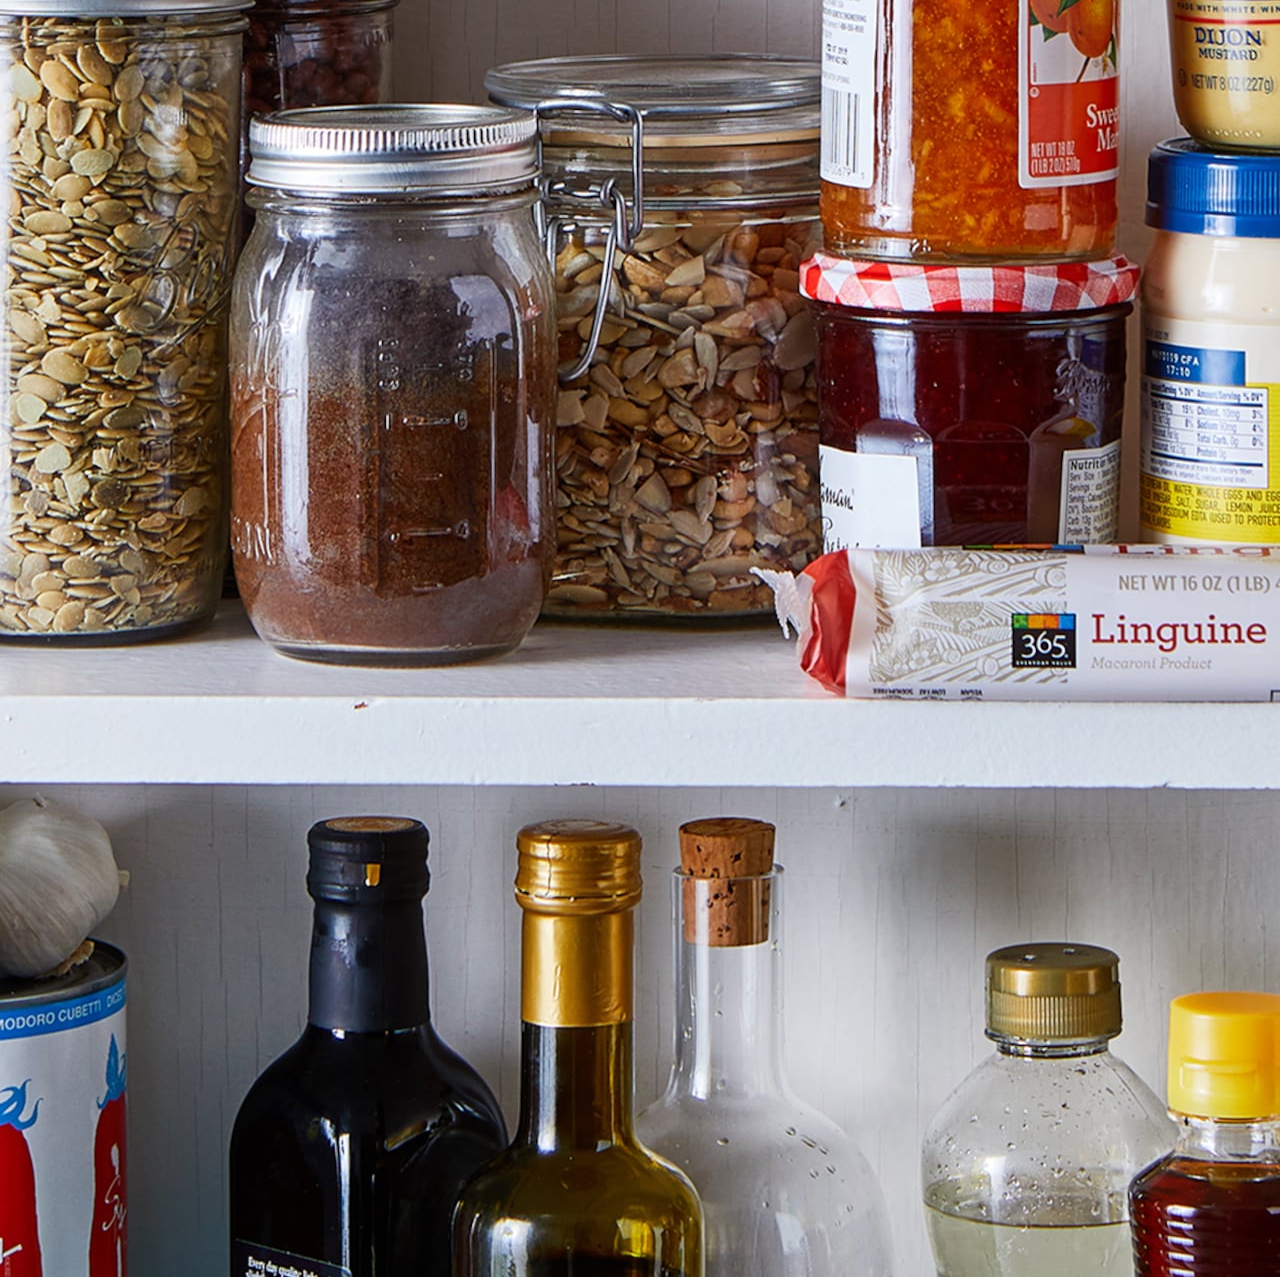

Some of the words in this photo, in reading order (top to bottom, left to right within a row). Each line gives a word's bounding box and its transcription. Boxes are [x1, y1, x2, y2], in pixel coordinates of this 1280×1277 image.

[1196, 3, 1219, 13] WITH
[1222, 4, 1256, 15] WHITE
[1194, 27, 1263, 48] DIJON
[1198, 48, 1259, 62] MUSTARD
[1227, 76, 1242, 92] OZ
[1242, 76, 1275, 94] (227g)
[1031, 142, 1045, 157] NET
[1046, 141, 1057, 157] WT
[1252, 423, 1264, 433] 4%
[1251, 436, 1264, 447] 0%
[1196, 486, 1220, 499] WHOLE
[1223, 489, 1243, 500] EGGS
[1245, 491, 1263, 501] AND
[1225, 502, 1253, 513] LEMON
[1234, 514, 1245, 525] TO
[1119, 574, 1146, 592] NET
[1149, 574, 1177, 592] WT
[1181, 574, 1199, 592] 16
[1203, 574, 1223, 592] OZ
[1227, 574, 1240, 594] (1
[1244, 574, 1271, 594] LB)
[1091, 614, 1267, 656] Linguine
[1091, 655, 1157, 670] Macaroni
[1159, 656, 1213, 673] Product
[58, 1000, 103, 1024] CUBETTI
